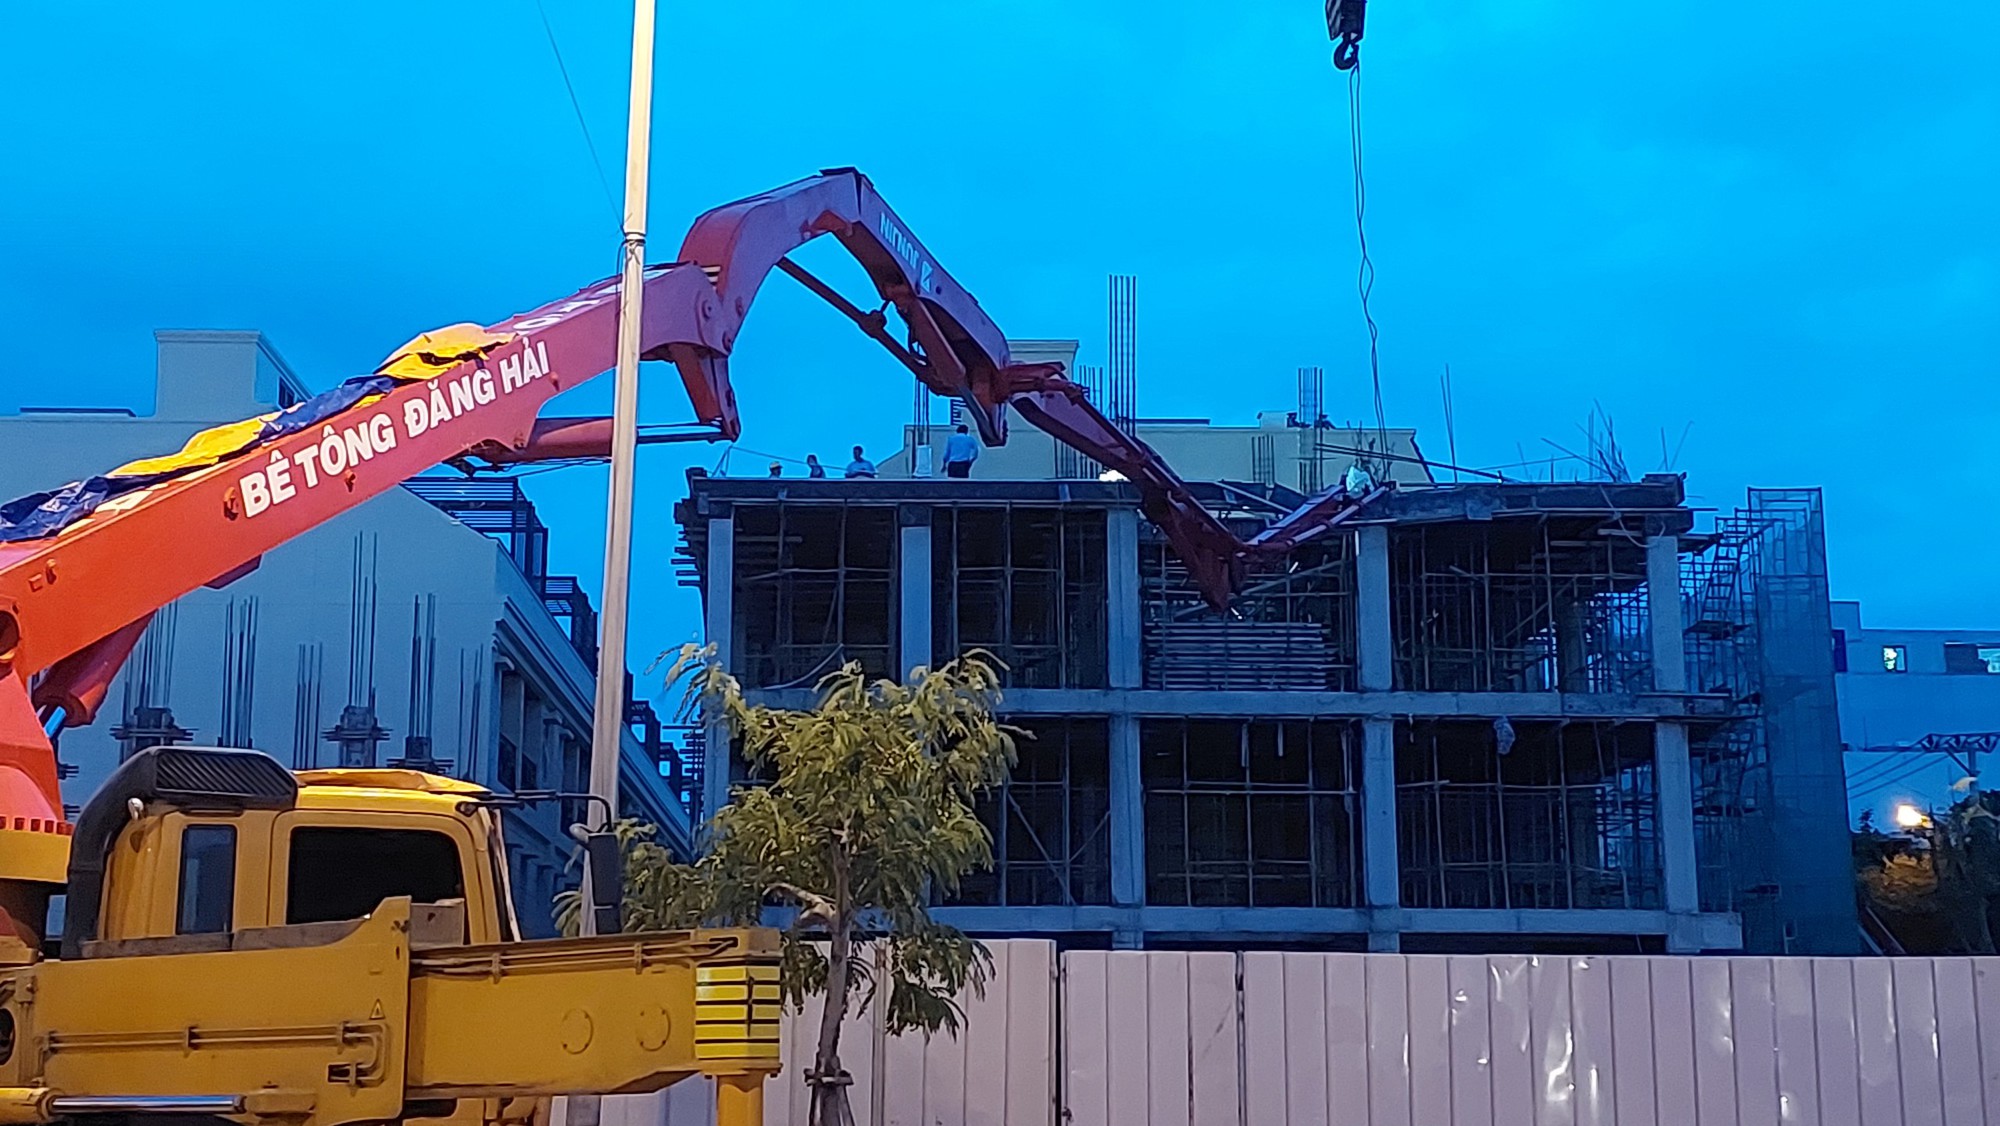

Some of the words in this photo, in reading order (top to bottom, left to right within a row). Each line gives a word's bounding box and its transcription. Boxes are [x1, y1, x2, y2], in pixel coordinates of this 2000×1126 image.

[239, 449, 296, 518] BÊ
[293, 413, 397, 488] TÔNG
[403, 368, 496, 438] ĐĂNG
[499, 336, 550, 394] HẢI
